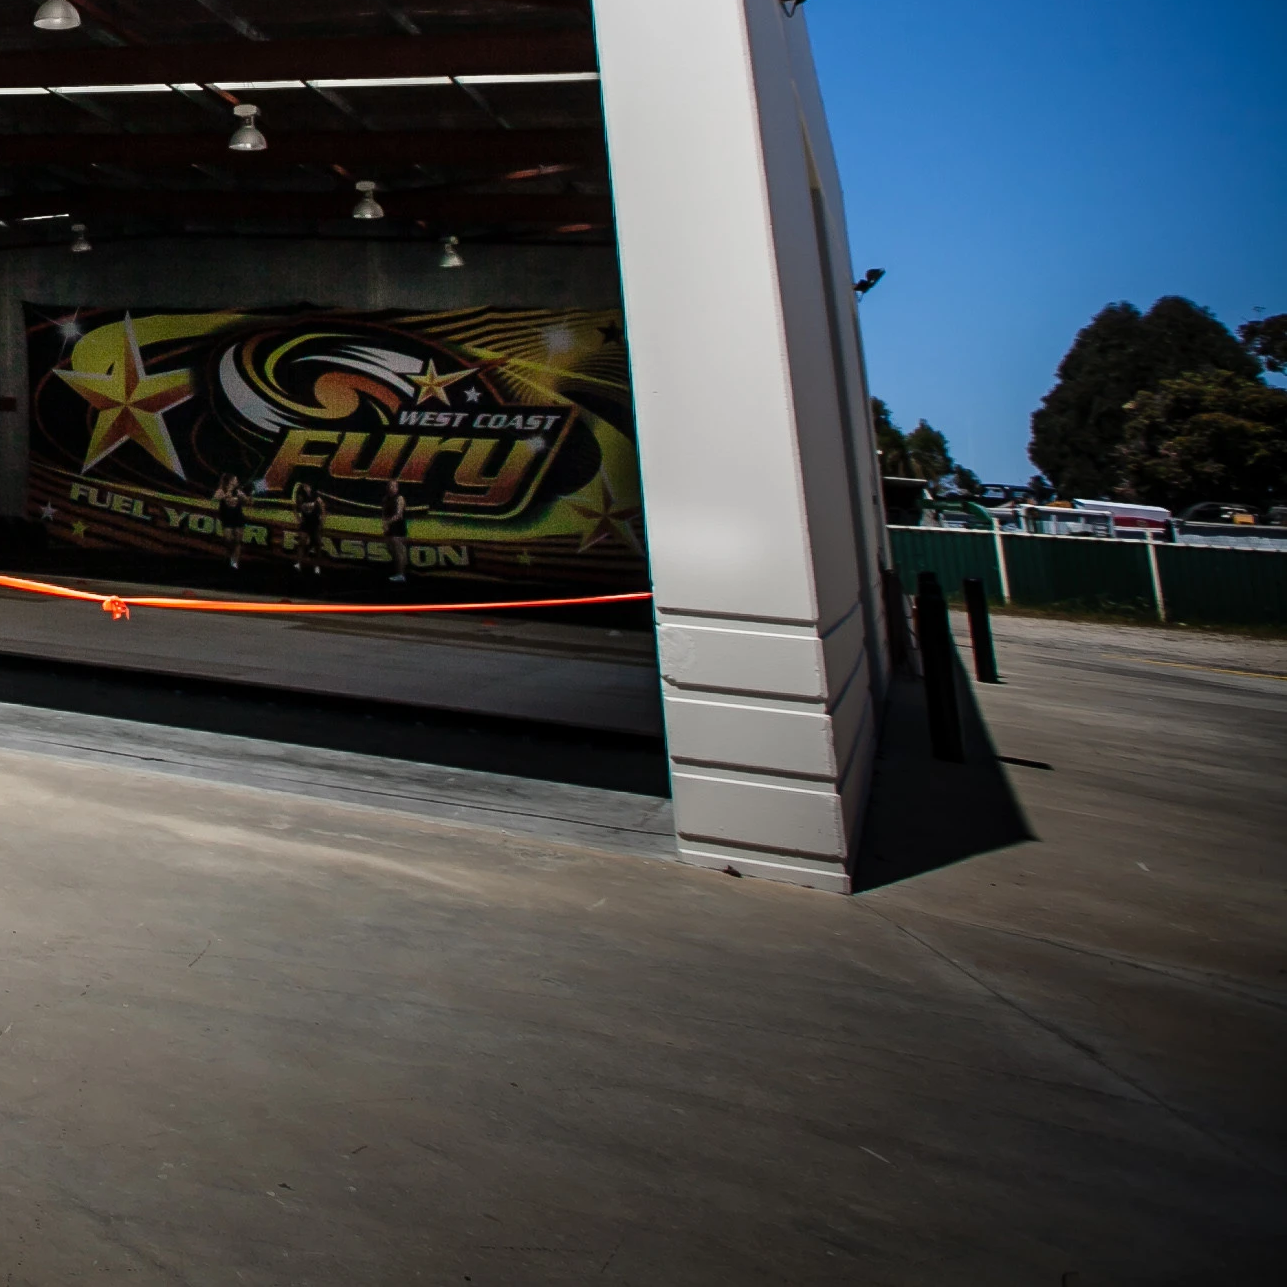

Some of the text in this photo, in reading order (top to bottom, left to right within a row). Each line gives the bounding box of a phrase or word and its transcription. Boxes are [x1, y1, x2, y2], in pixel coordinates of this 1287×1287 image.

[398, 410, 561, 431] WEST COAST
[264, 428, 537, 506] Fury
[69, 481, 152, 521] FUEL
